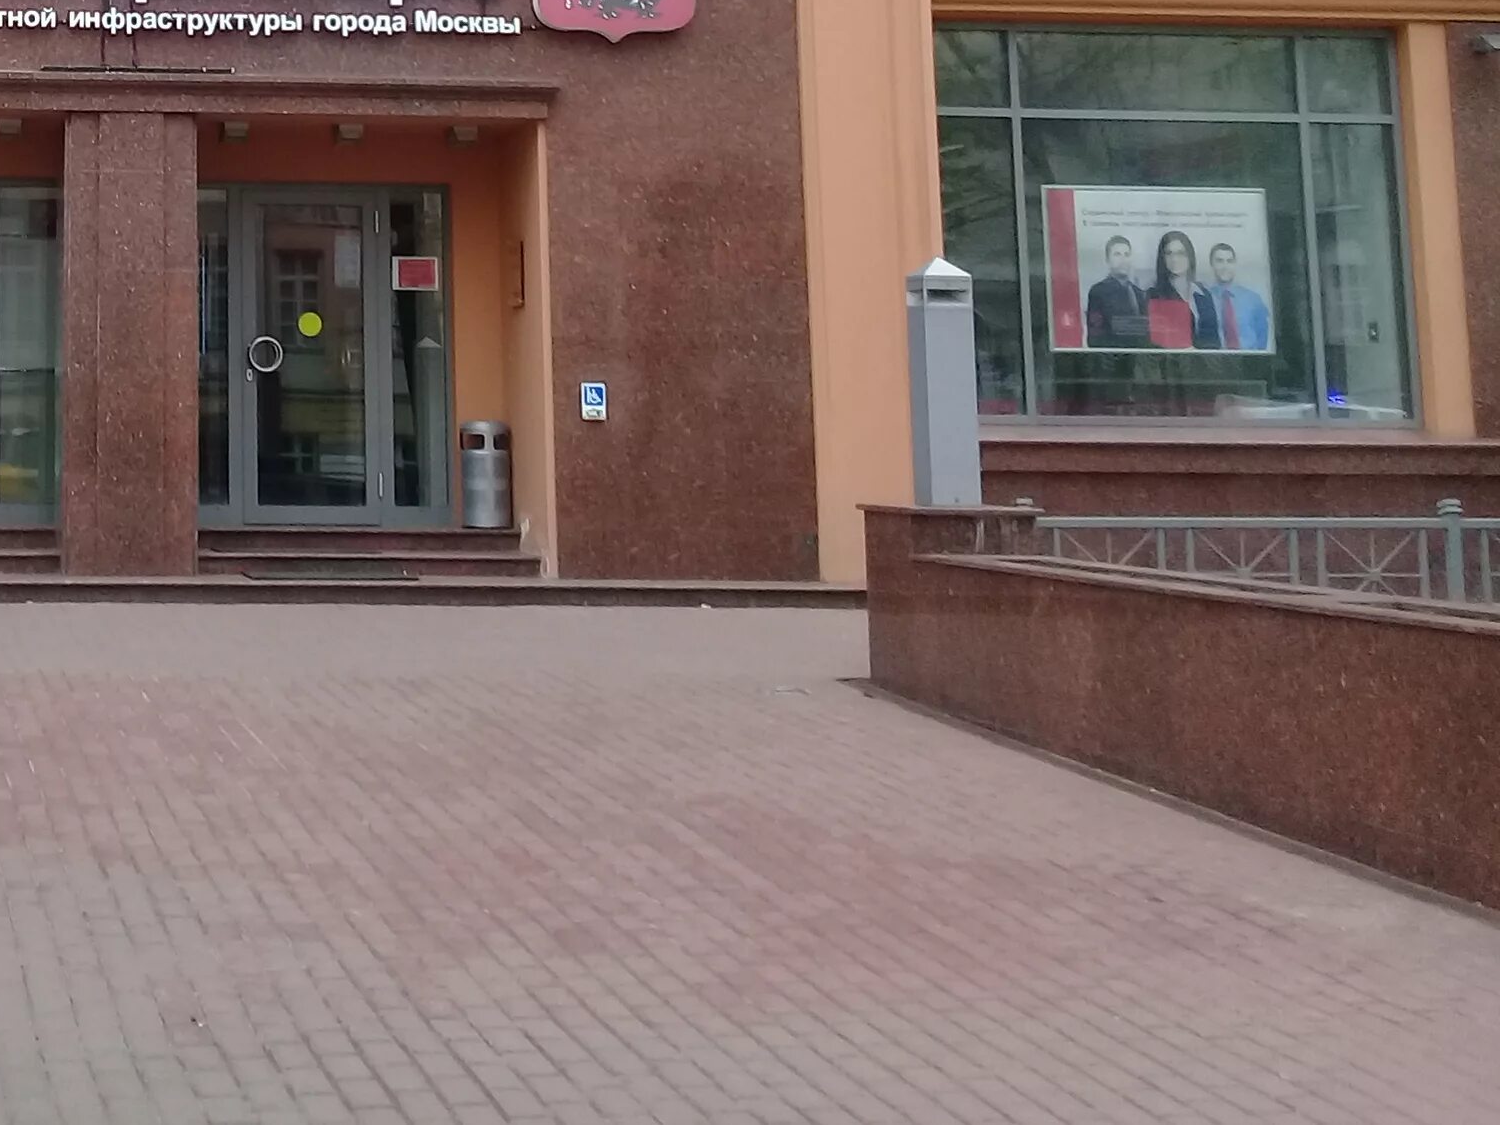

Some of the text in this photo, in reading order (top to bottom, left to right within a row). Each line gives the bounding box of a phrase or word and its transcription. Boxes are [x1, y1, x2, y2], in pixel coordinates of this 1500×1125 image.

[69, 8, 302, 36] инфраструктуры
[313, 13, 406, 37] города
[415, 10, 521, 34] Москвы
